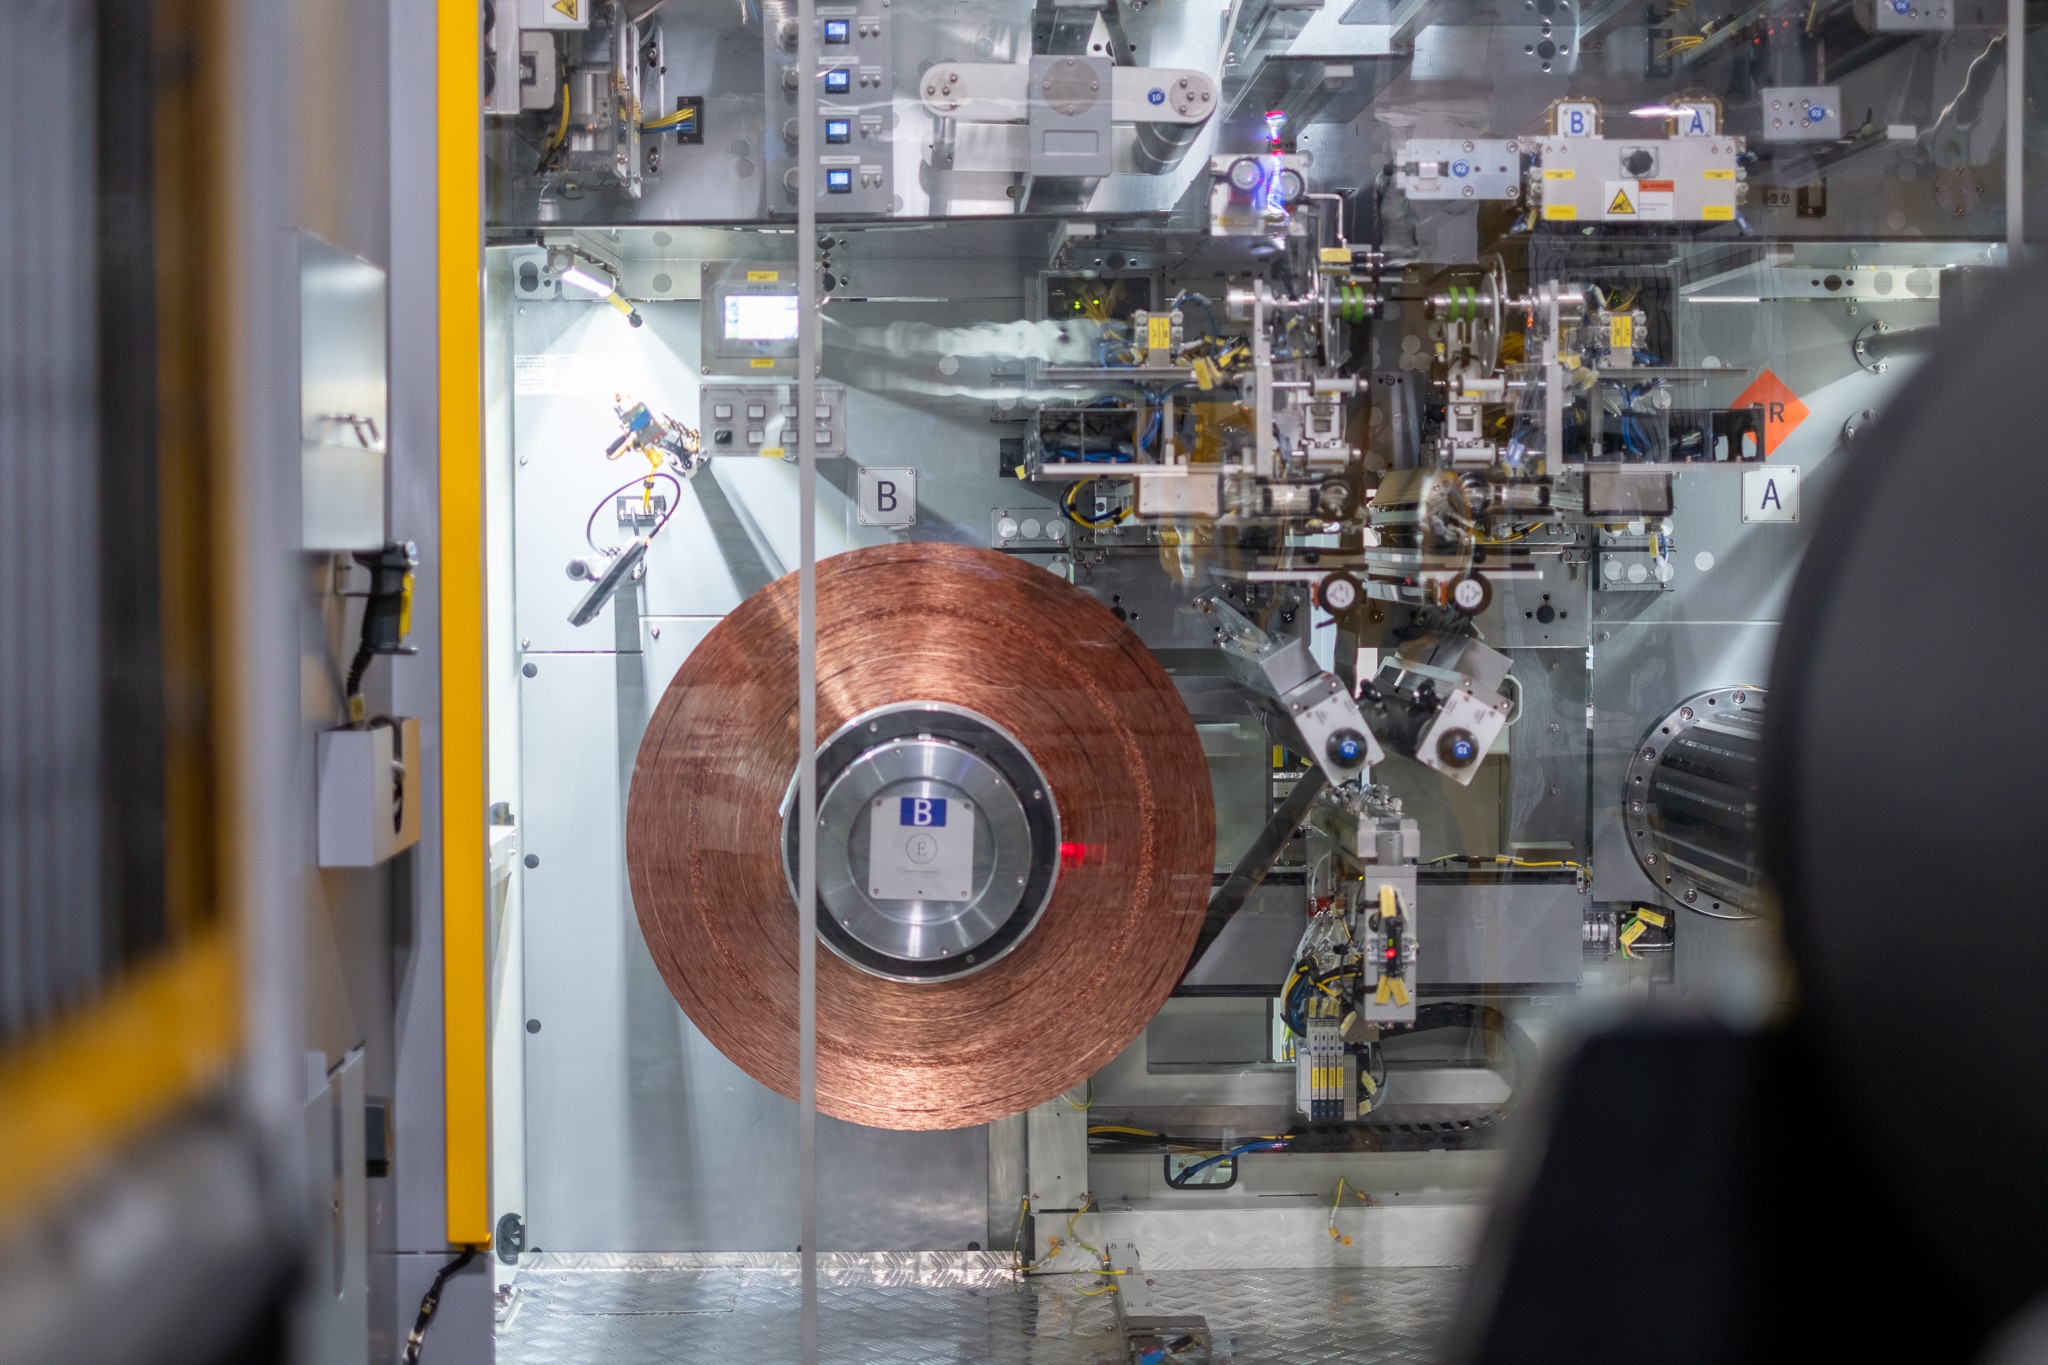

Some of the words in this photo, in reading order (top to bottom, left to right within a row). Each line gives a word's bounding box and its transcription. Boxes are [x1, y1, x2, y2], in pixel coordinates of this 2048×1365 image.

[1152, 93, 1162, 102] 10
[1570, 111, 1585, 134] B
[1690, 111, 1705, 134] A
[877, 480, 898, 512] B
[1760, 478, 1782, 510] A
[913, 798, 933, 826] B
[917, 840, 928, 857] E
